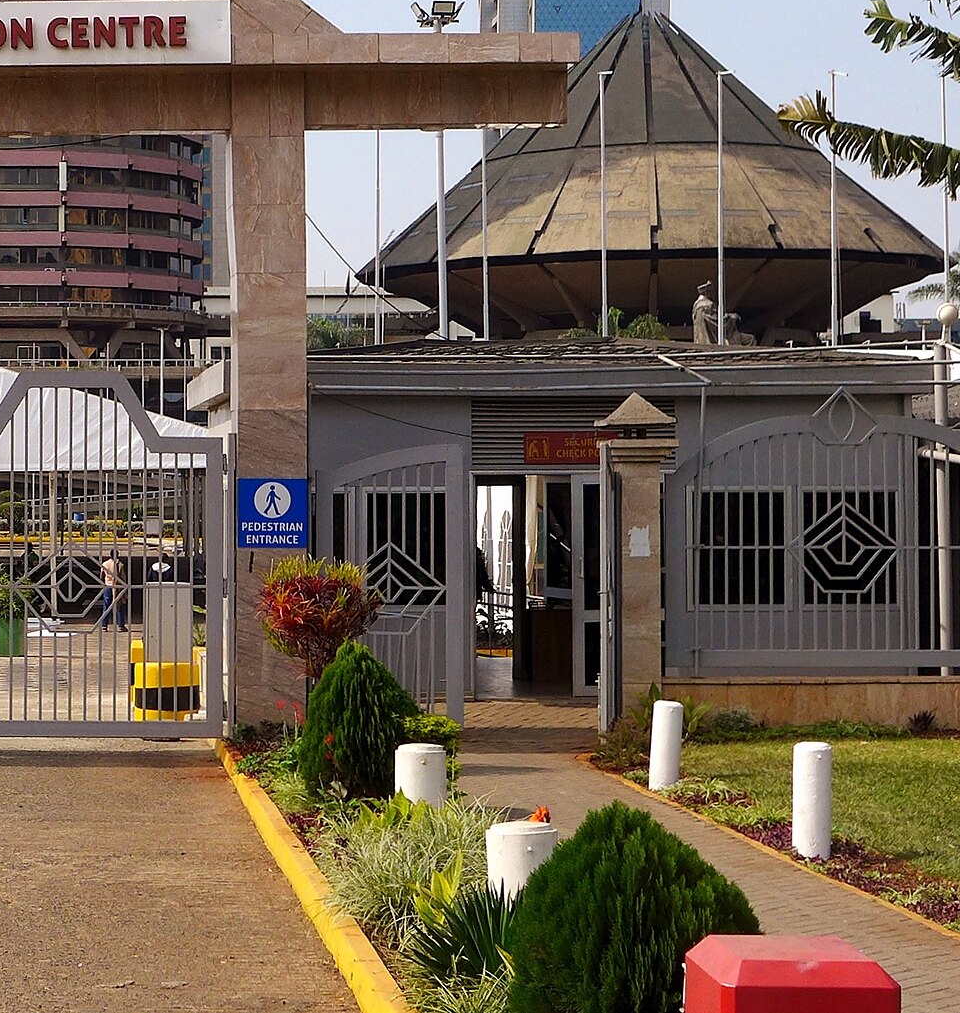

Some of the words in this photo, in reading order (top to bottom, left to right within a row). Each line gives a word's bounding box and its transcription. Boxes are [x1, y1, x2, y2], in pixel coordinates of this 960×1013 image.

[47, 15, 188, 48] CENTRE
[556, 449, 587, 458] CHECK
[241, 521, 304, 532] PEDESTRIAN
[246, 534, 299, 545] ENTRANCE
